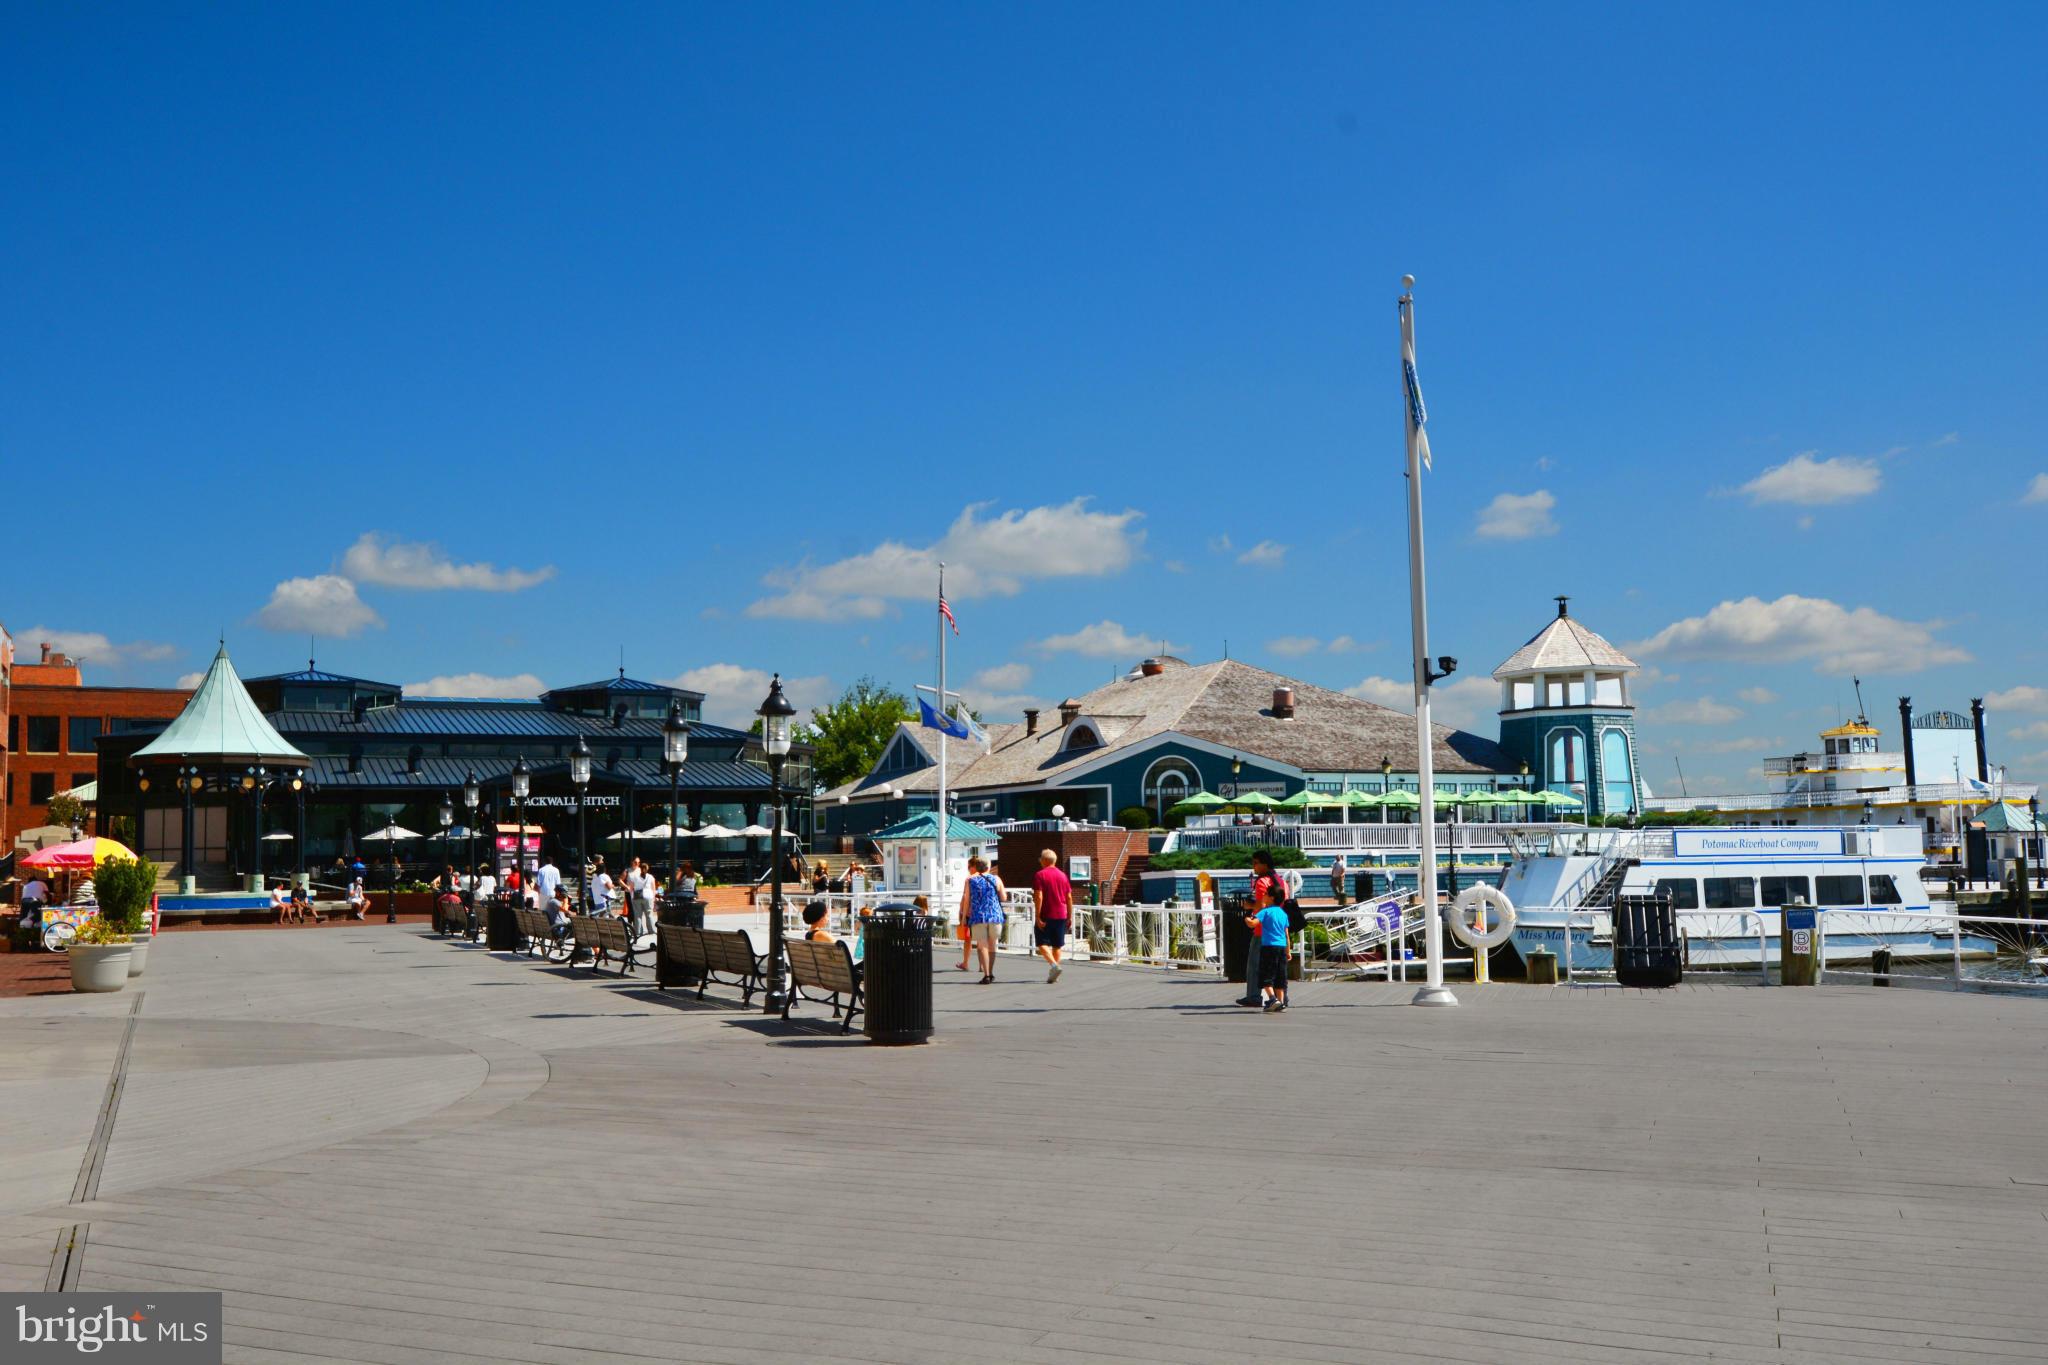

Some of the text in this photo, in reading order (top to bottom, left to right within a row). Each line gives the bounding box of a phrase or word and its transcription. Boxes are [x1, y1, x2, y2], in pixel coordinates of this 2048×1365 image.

[510, 796, 620, 806] BACKWALL HITCH
[1702, 838, 1819, 851] Potomac Riverboat Company
[1518, 929, 1543, 940] Miss
